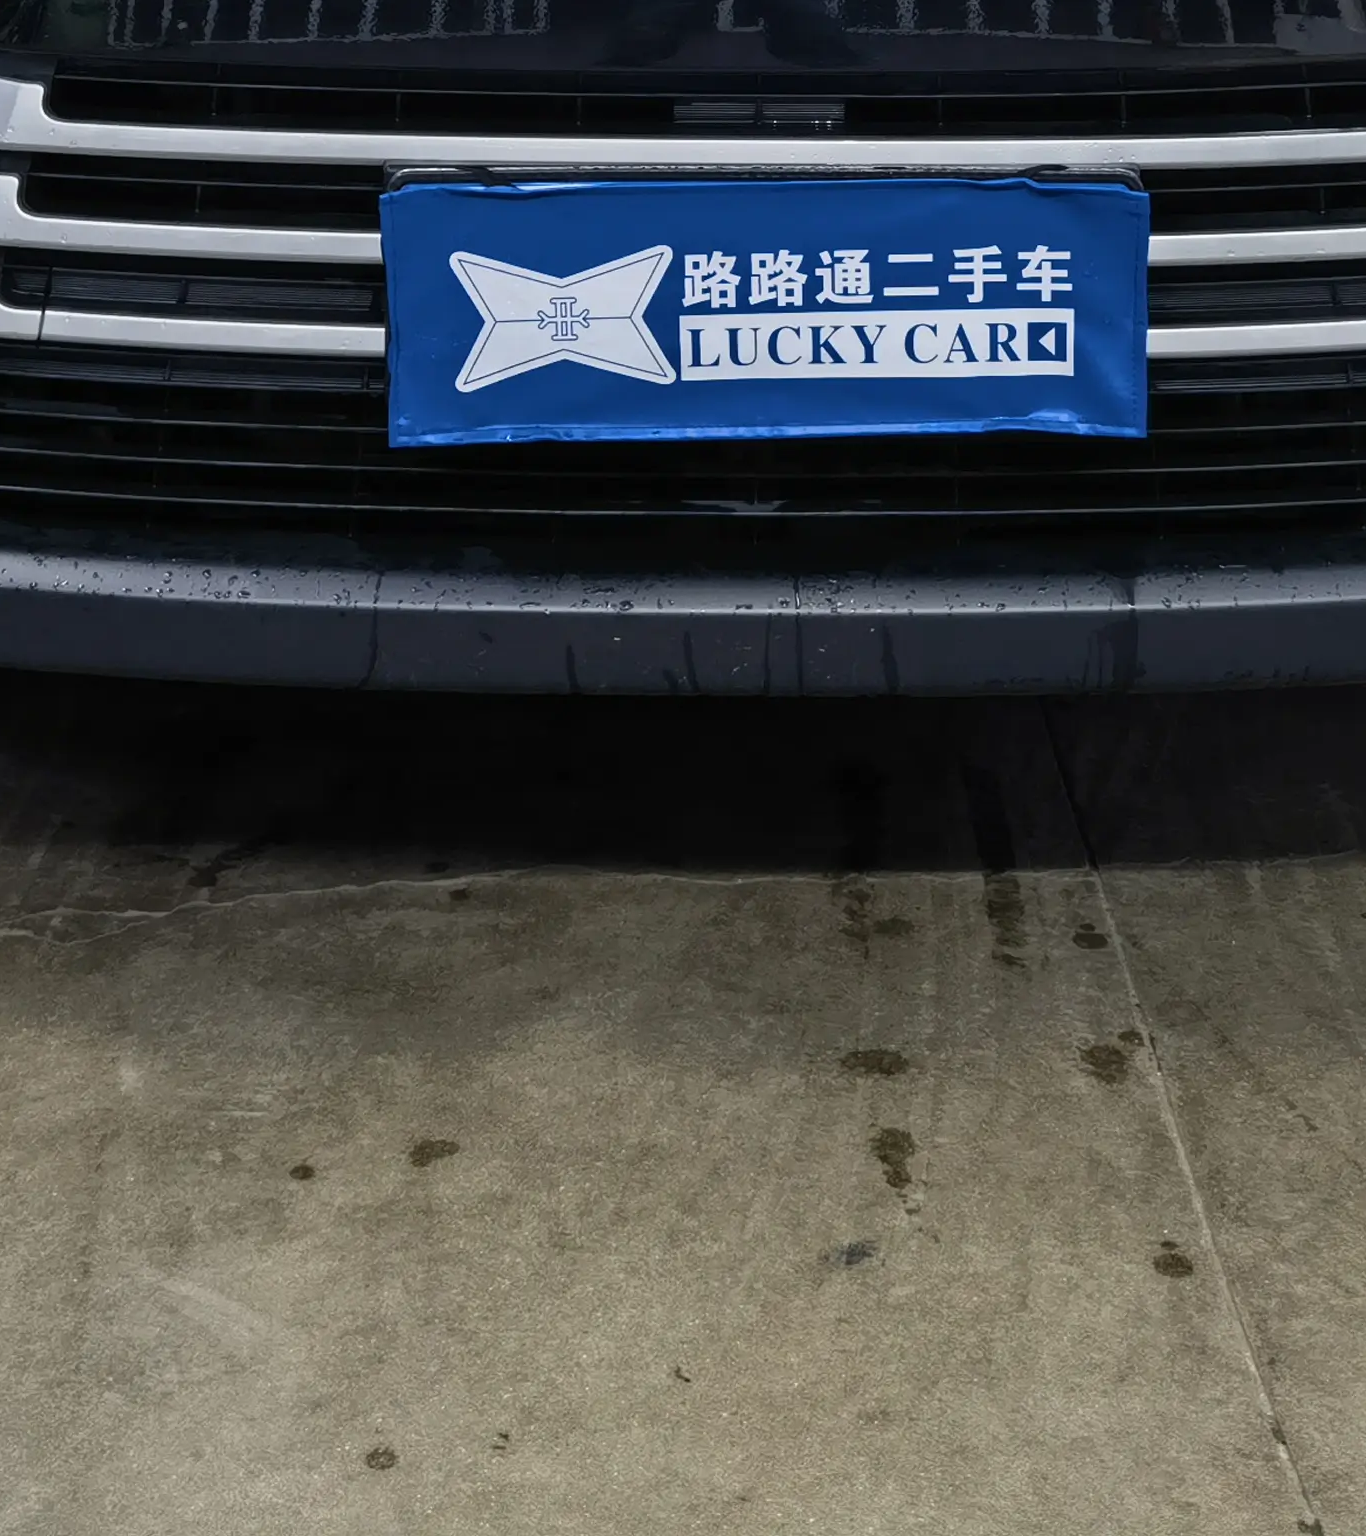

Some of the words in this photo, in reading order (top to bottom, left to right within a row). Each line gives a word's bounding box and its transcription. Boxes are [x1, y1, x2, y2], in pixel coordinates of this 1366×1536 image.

[682, 244, 1073, 308] 路路通二手车
[687, 324, 887, 368] LUCKY
[904, 322, 1021, 364] CAR
